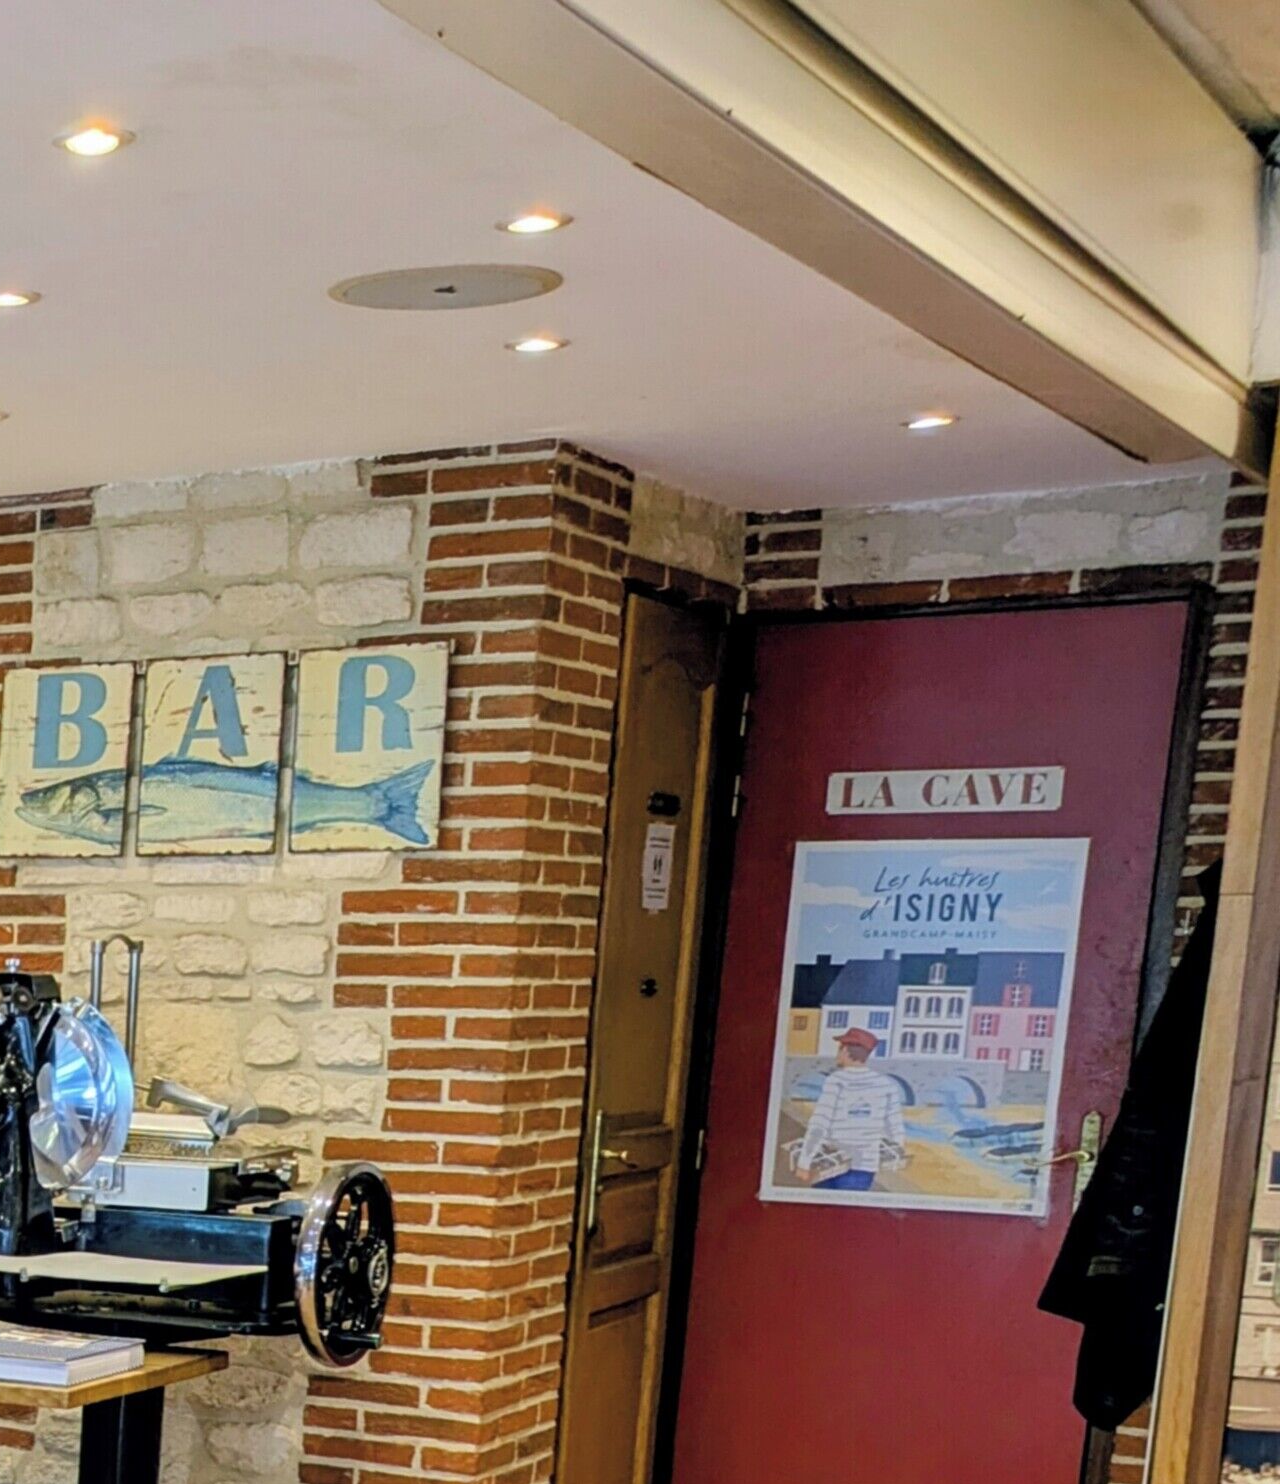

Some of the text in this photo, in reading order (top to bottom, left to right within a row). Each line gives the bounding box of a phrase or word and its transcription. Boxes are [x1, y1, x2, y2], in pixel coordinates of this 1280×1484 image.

[32, 655, 416, 770] BAR
[842, 772, 1048, 808] LA CAVE
[874, 866, 910, 893] Les
